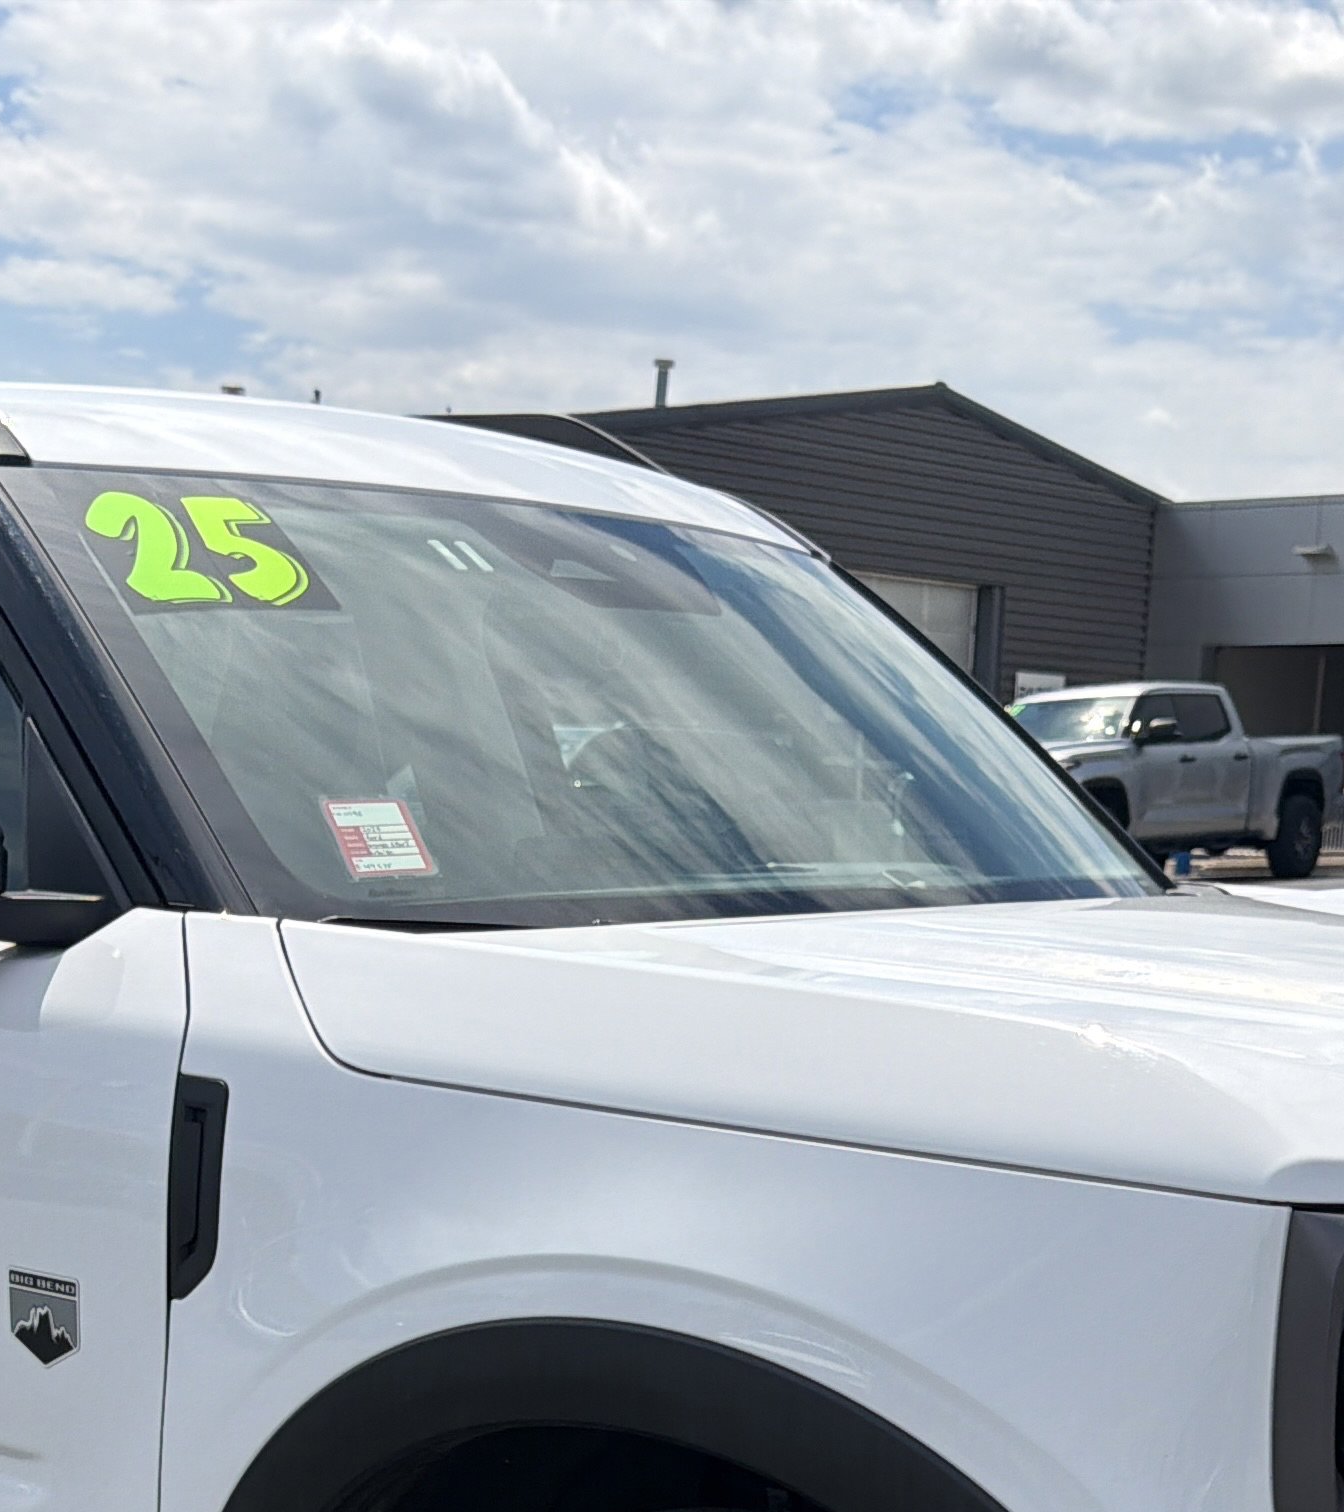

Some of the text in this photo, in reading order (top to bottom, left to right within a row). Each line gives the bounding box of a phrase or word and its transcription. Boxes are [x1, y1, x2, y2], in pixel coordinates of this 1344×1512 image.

[84, 490, 310, 607] 25
[10, 1272, 75, 1294] BIG BEND
